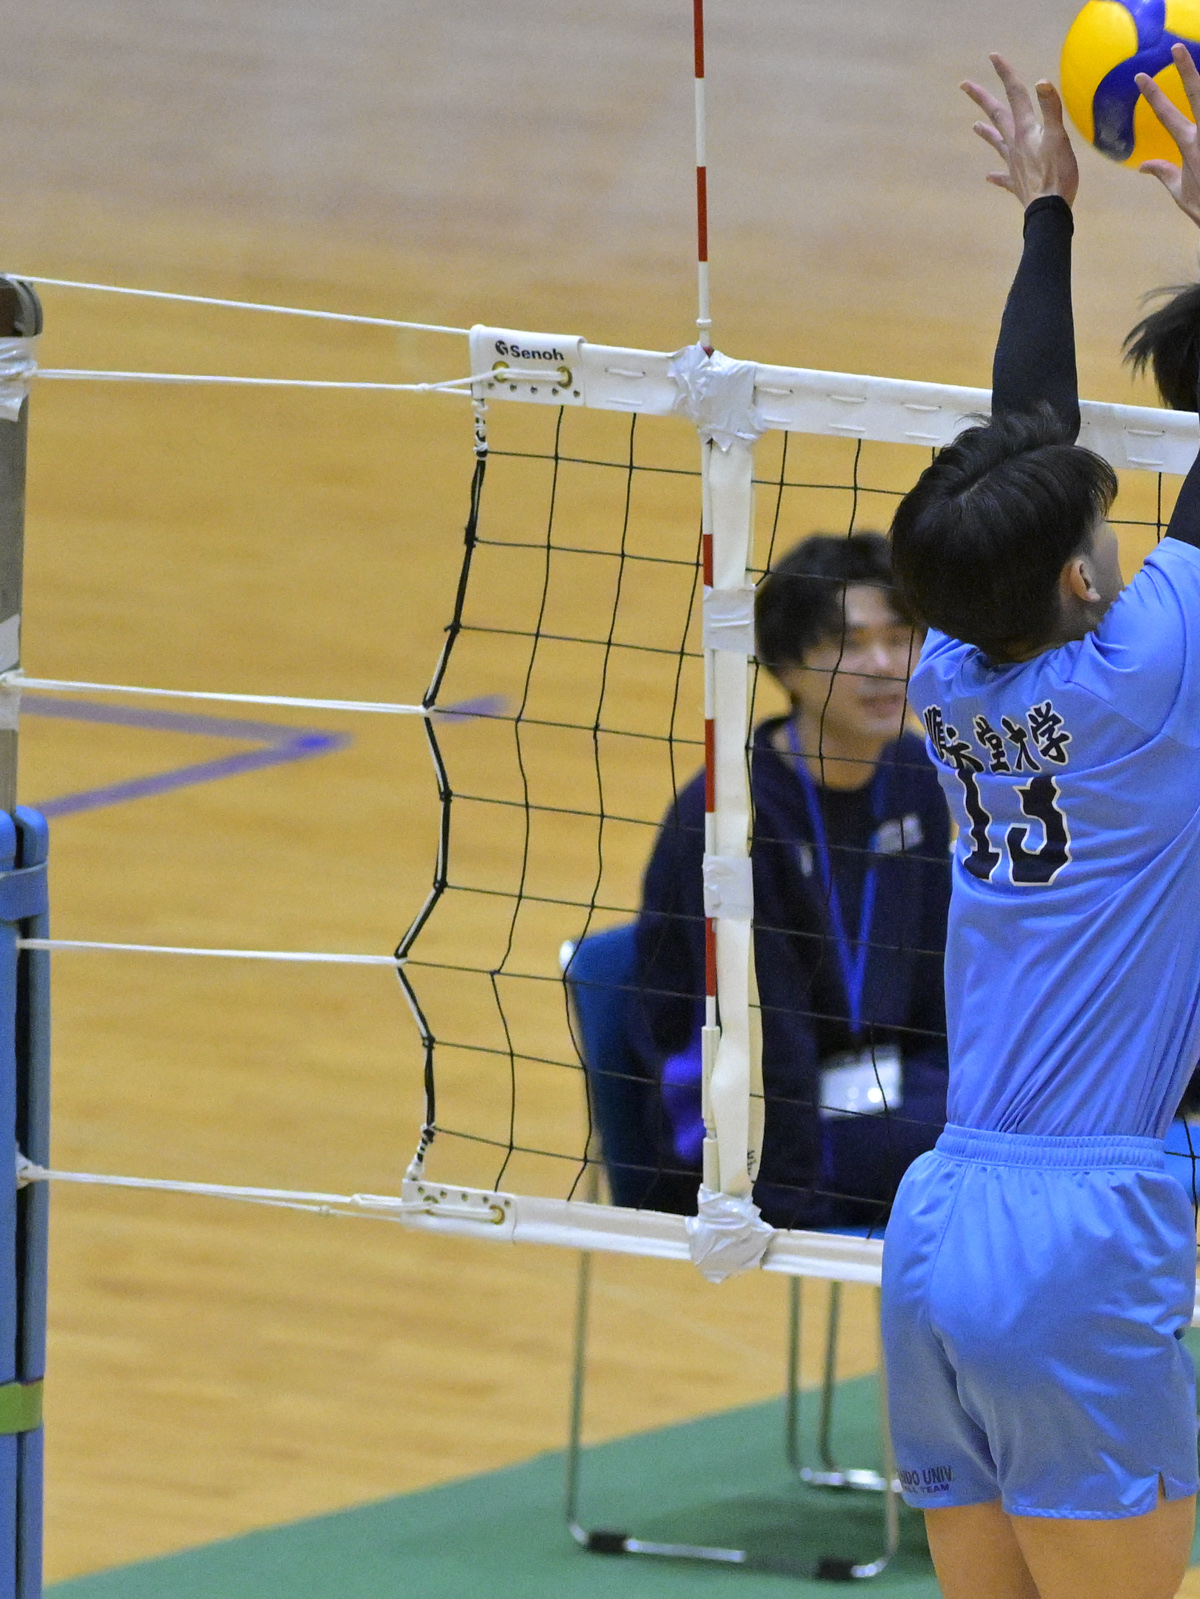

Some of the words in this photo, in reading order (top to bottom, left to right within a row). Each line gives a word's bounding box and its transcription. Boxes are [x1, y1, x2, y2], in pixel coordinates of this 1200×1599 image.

[509, 344, 565, 361] Senoh
[922, 1465, 952, 1484] UNIV
[920, 1483, 950, 1494] TEAM
